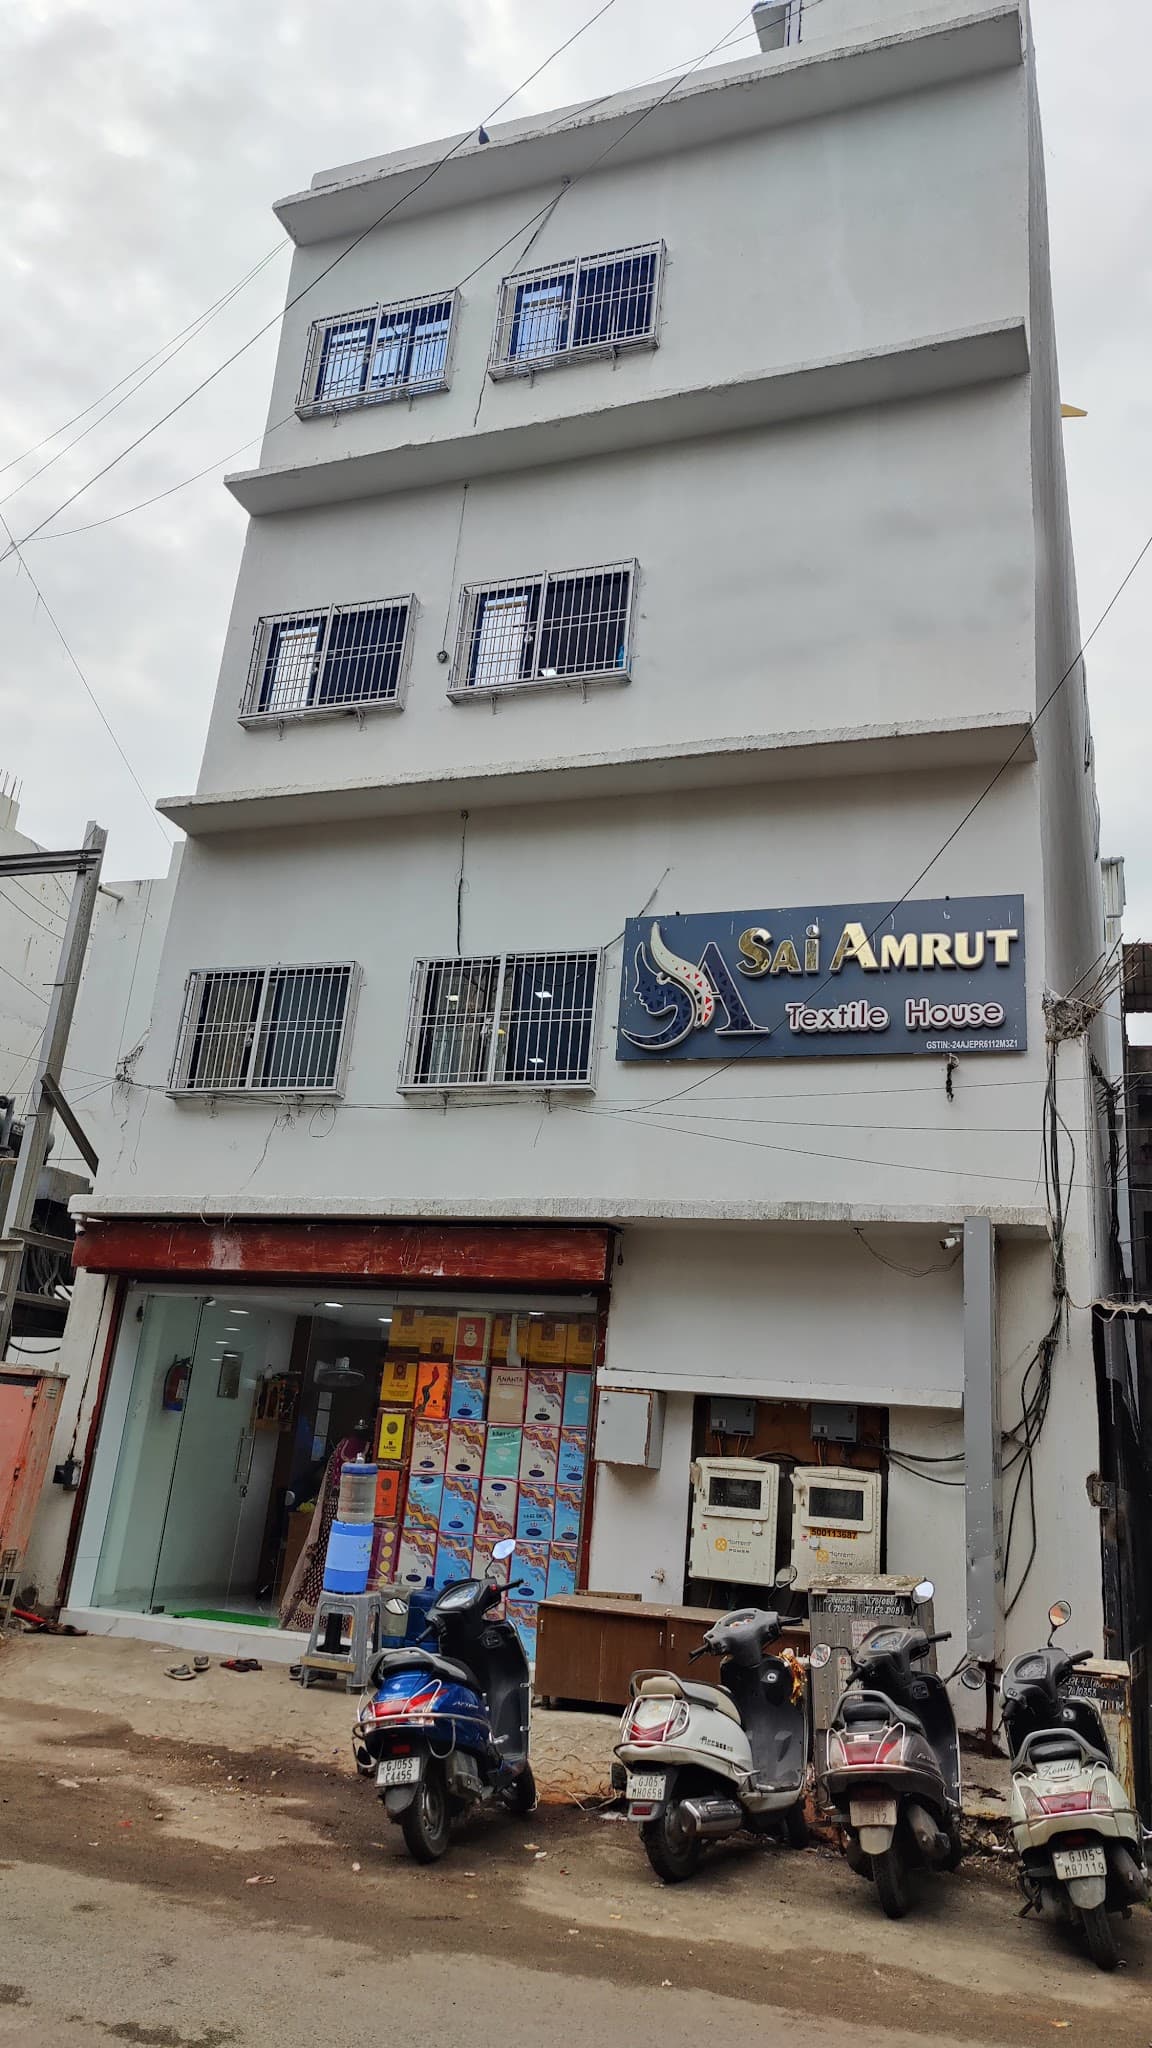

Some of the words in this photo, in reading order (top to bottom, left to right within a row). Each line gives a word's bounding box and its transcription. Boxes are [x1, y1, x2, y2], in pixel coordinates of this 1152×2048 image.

[829, 921, 1018, 970] AMRUT
[784, 999, 890, 1031] Textile
[904, 997, 1005, 1030] House
[1069, 1849, 1095, 1862] GJ05
